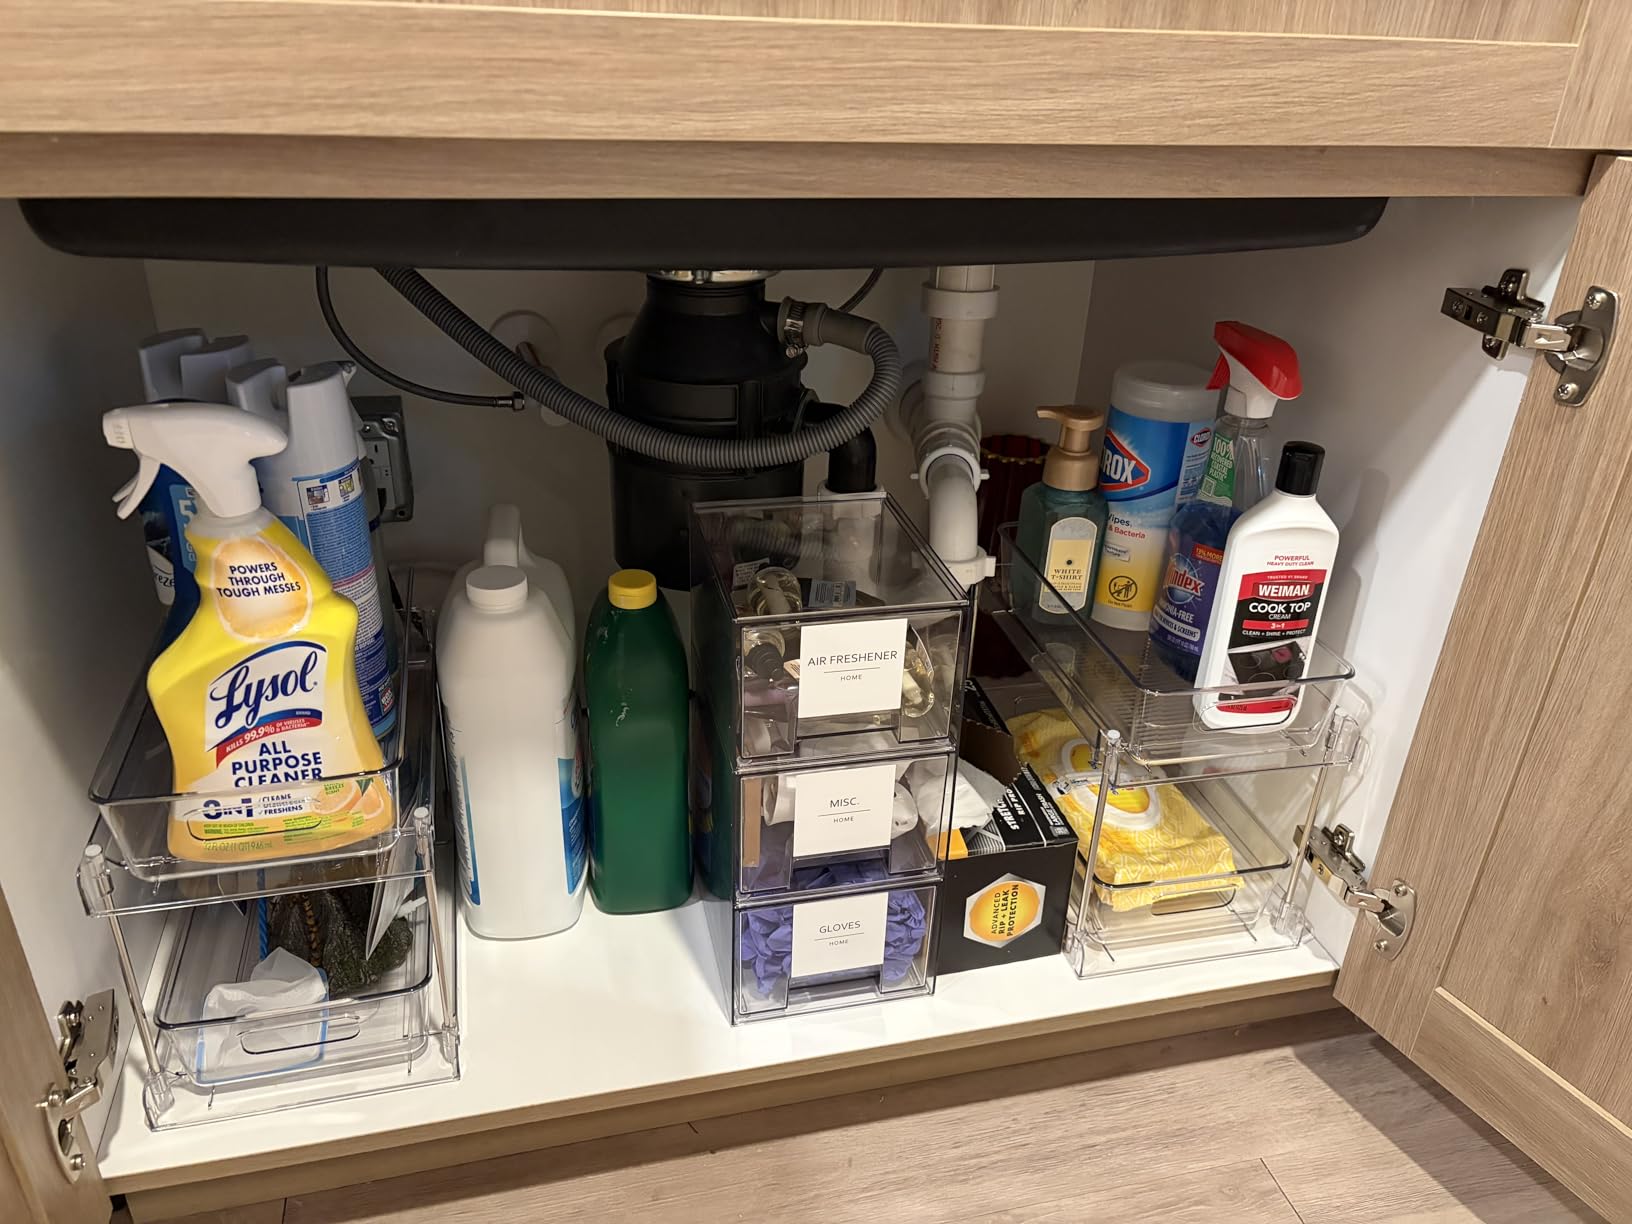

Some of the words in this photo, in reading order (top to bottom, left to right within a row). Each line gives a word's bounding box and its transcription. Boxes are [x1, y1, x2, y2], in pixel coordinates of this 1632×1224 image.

[1102, 448, 1134, 485] ROX
[1114, 527, 1146, 539] Bacteria
[229, 562, 277, 574] POWERS
[228, 572, 286, 586] THROUGH
[216, 587, 260, 598] TOUGH
[264, 581, 301, 596] MESSES
[1258, 583, 1310, 597] WEIMAN
[1249, 602, 1287, 614] COOK
[1289, 601, 1312, 613] TOP
[807, 656, 827, 667] AIR
[829, 650, 898, 665] FRESHENER
[209, 651, 317, 729] Lysol
[225, 738, 244, 753] KILLS
[244, 724, 275, 744] 99.9%
[259, 740, 291, 756] ALL
[232, 752, 322, 775] PURPOSE
[264, 804, 303, 815] FRESHENS
[830, 797, 860, 808] MISC.
[1014, 803, 1025, 815] RIP
[1001, 889, 1010, 912] LEAK
[991, 892, 1001, 934] ADVANCED
[1007, 884, 1019, 936] PROTECTION
[819, 920, 861, 934] GLOVES
[998, 921, 1006, 934] RIP
